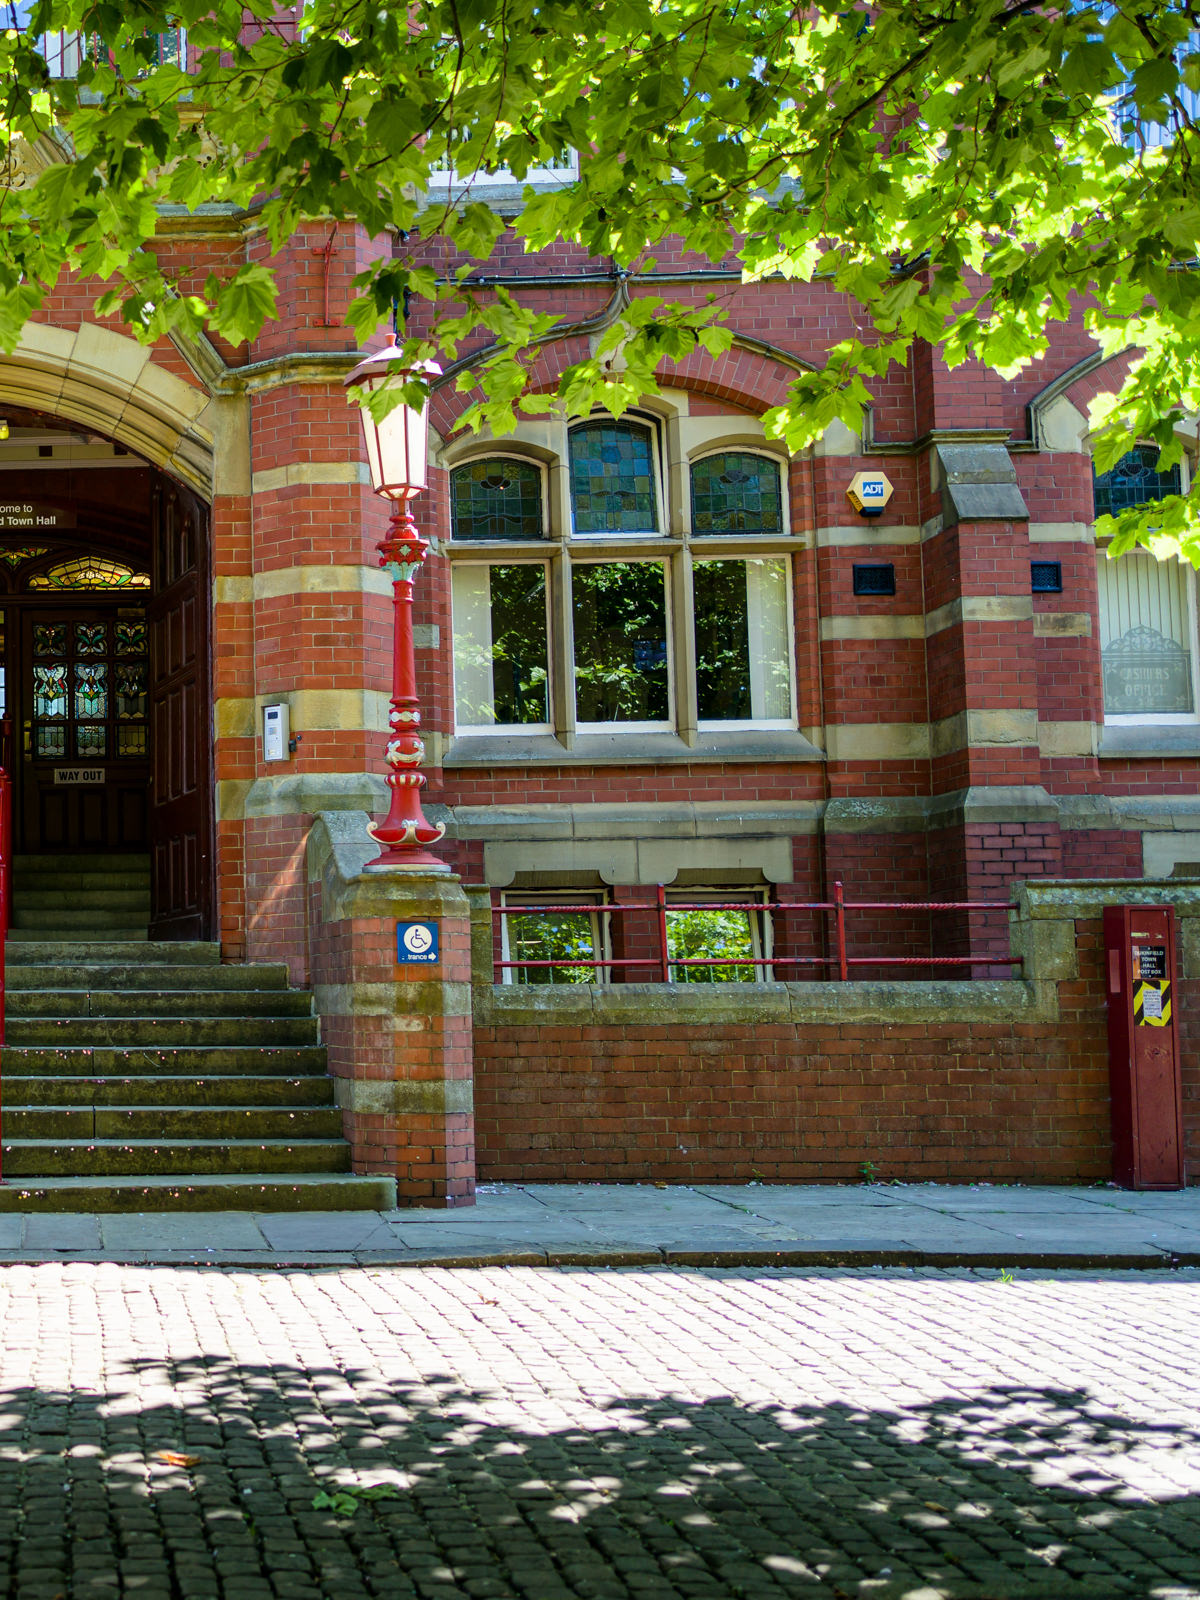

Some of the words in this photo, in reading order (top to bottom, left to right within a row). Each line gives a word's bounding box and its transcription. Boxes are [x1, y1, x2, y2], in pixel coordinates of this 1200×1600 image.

[863, 485, 883, 494] ADT
[23, 504, 33, 513] to
[7, 516, 33, 526] Town
[36, 516, 56, 525] Hall
[59, 771, 79, 780] WAY
[83, 771, 102, 780] OUT
